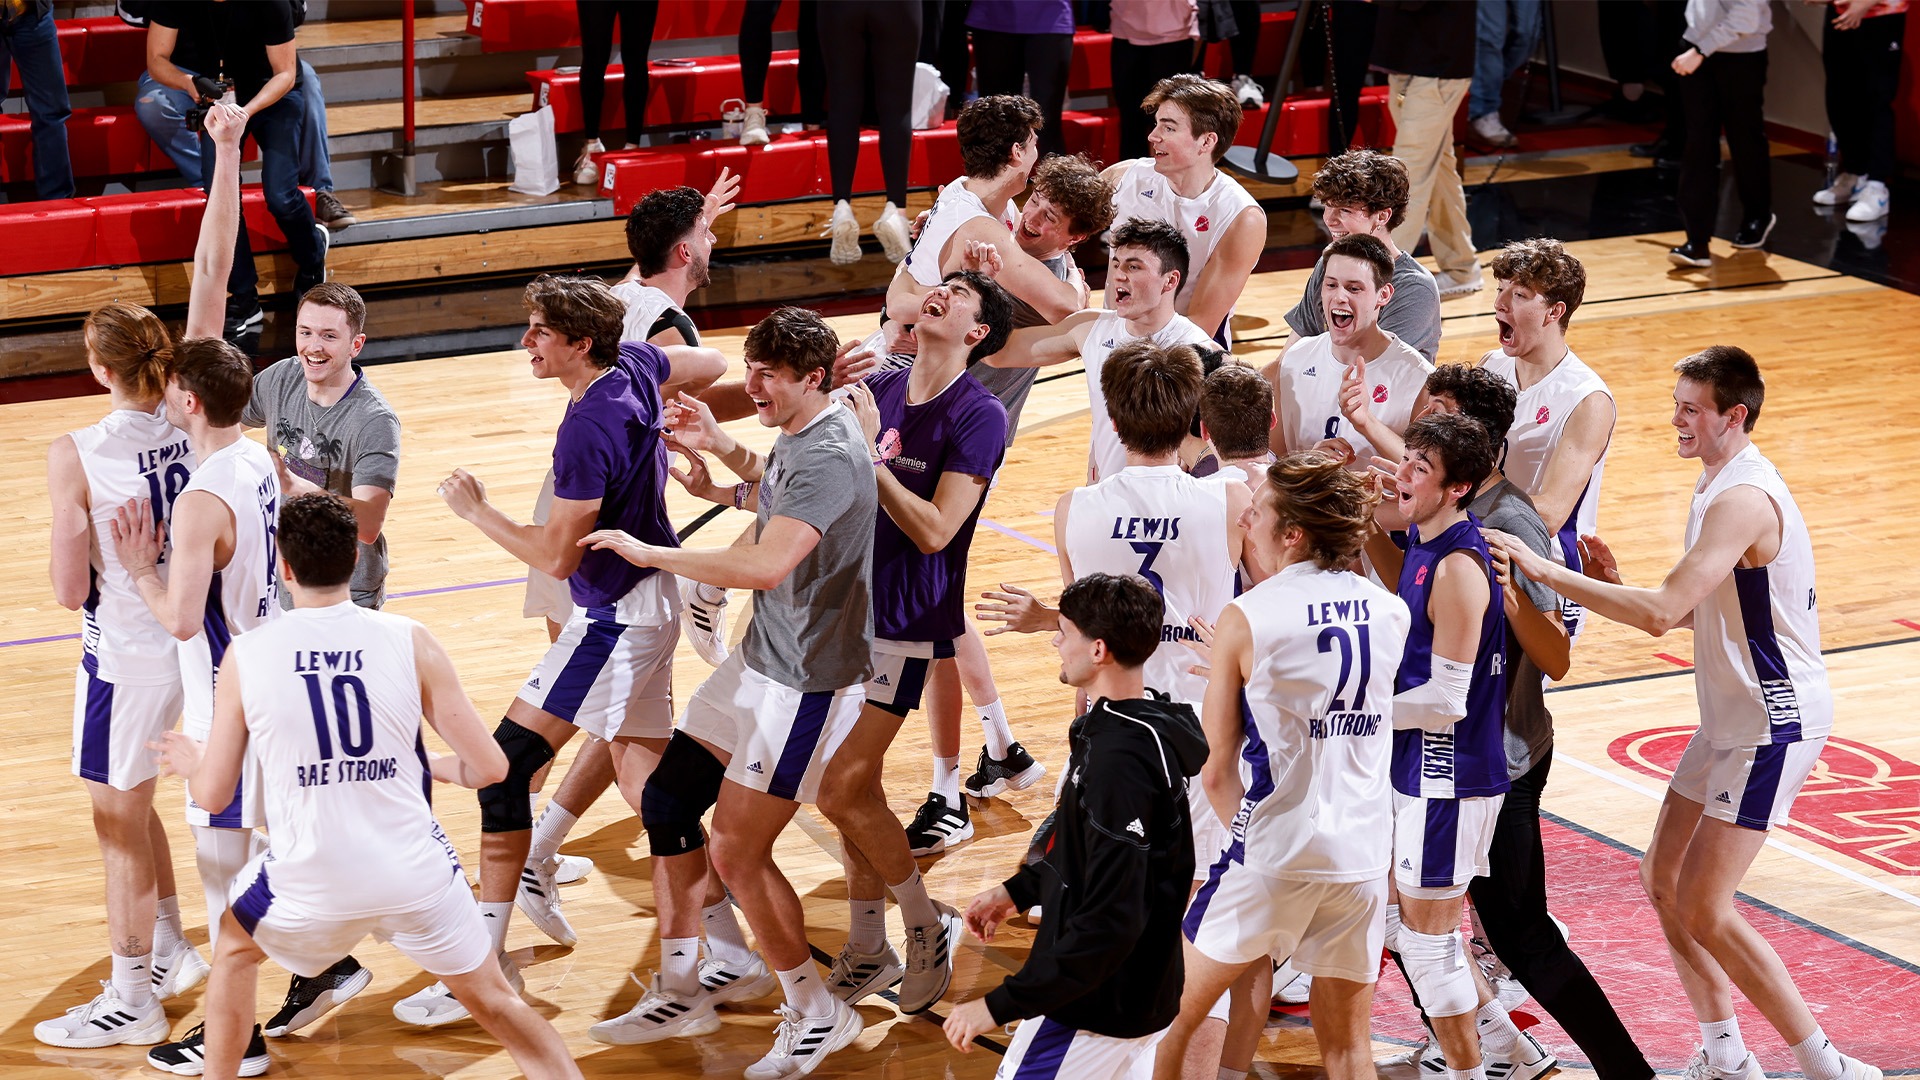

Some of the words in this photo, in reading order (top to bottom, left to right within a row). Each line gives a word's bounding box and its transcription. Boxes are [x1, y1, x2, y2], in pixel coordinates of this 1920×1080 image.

[138, 439, 188, 475] LEWIS
[1110, 517, 1181, 541] LEWIS
[1129, 542, 1166, 617] 3
[1307, 599, 1370, 626] LEWIS
[294, 650, 364, 672] LEWIS
[1317, 624, 1371, 715] 21
[300, 674, 374, 760] 10
[1762, 679, 1801, 725] FLYERS
[1330, 713, 1382, 737] STRONG
[297, 763, 330, 787] RAE
[338, 757, 397, 783] STRONG
[1423, 731, 1453, 781] FLYERS
